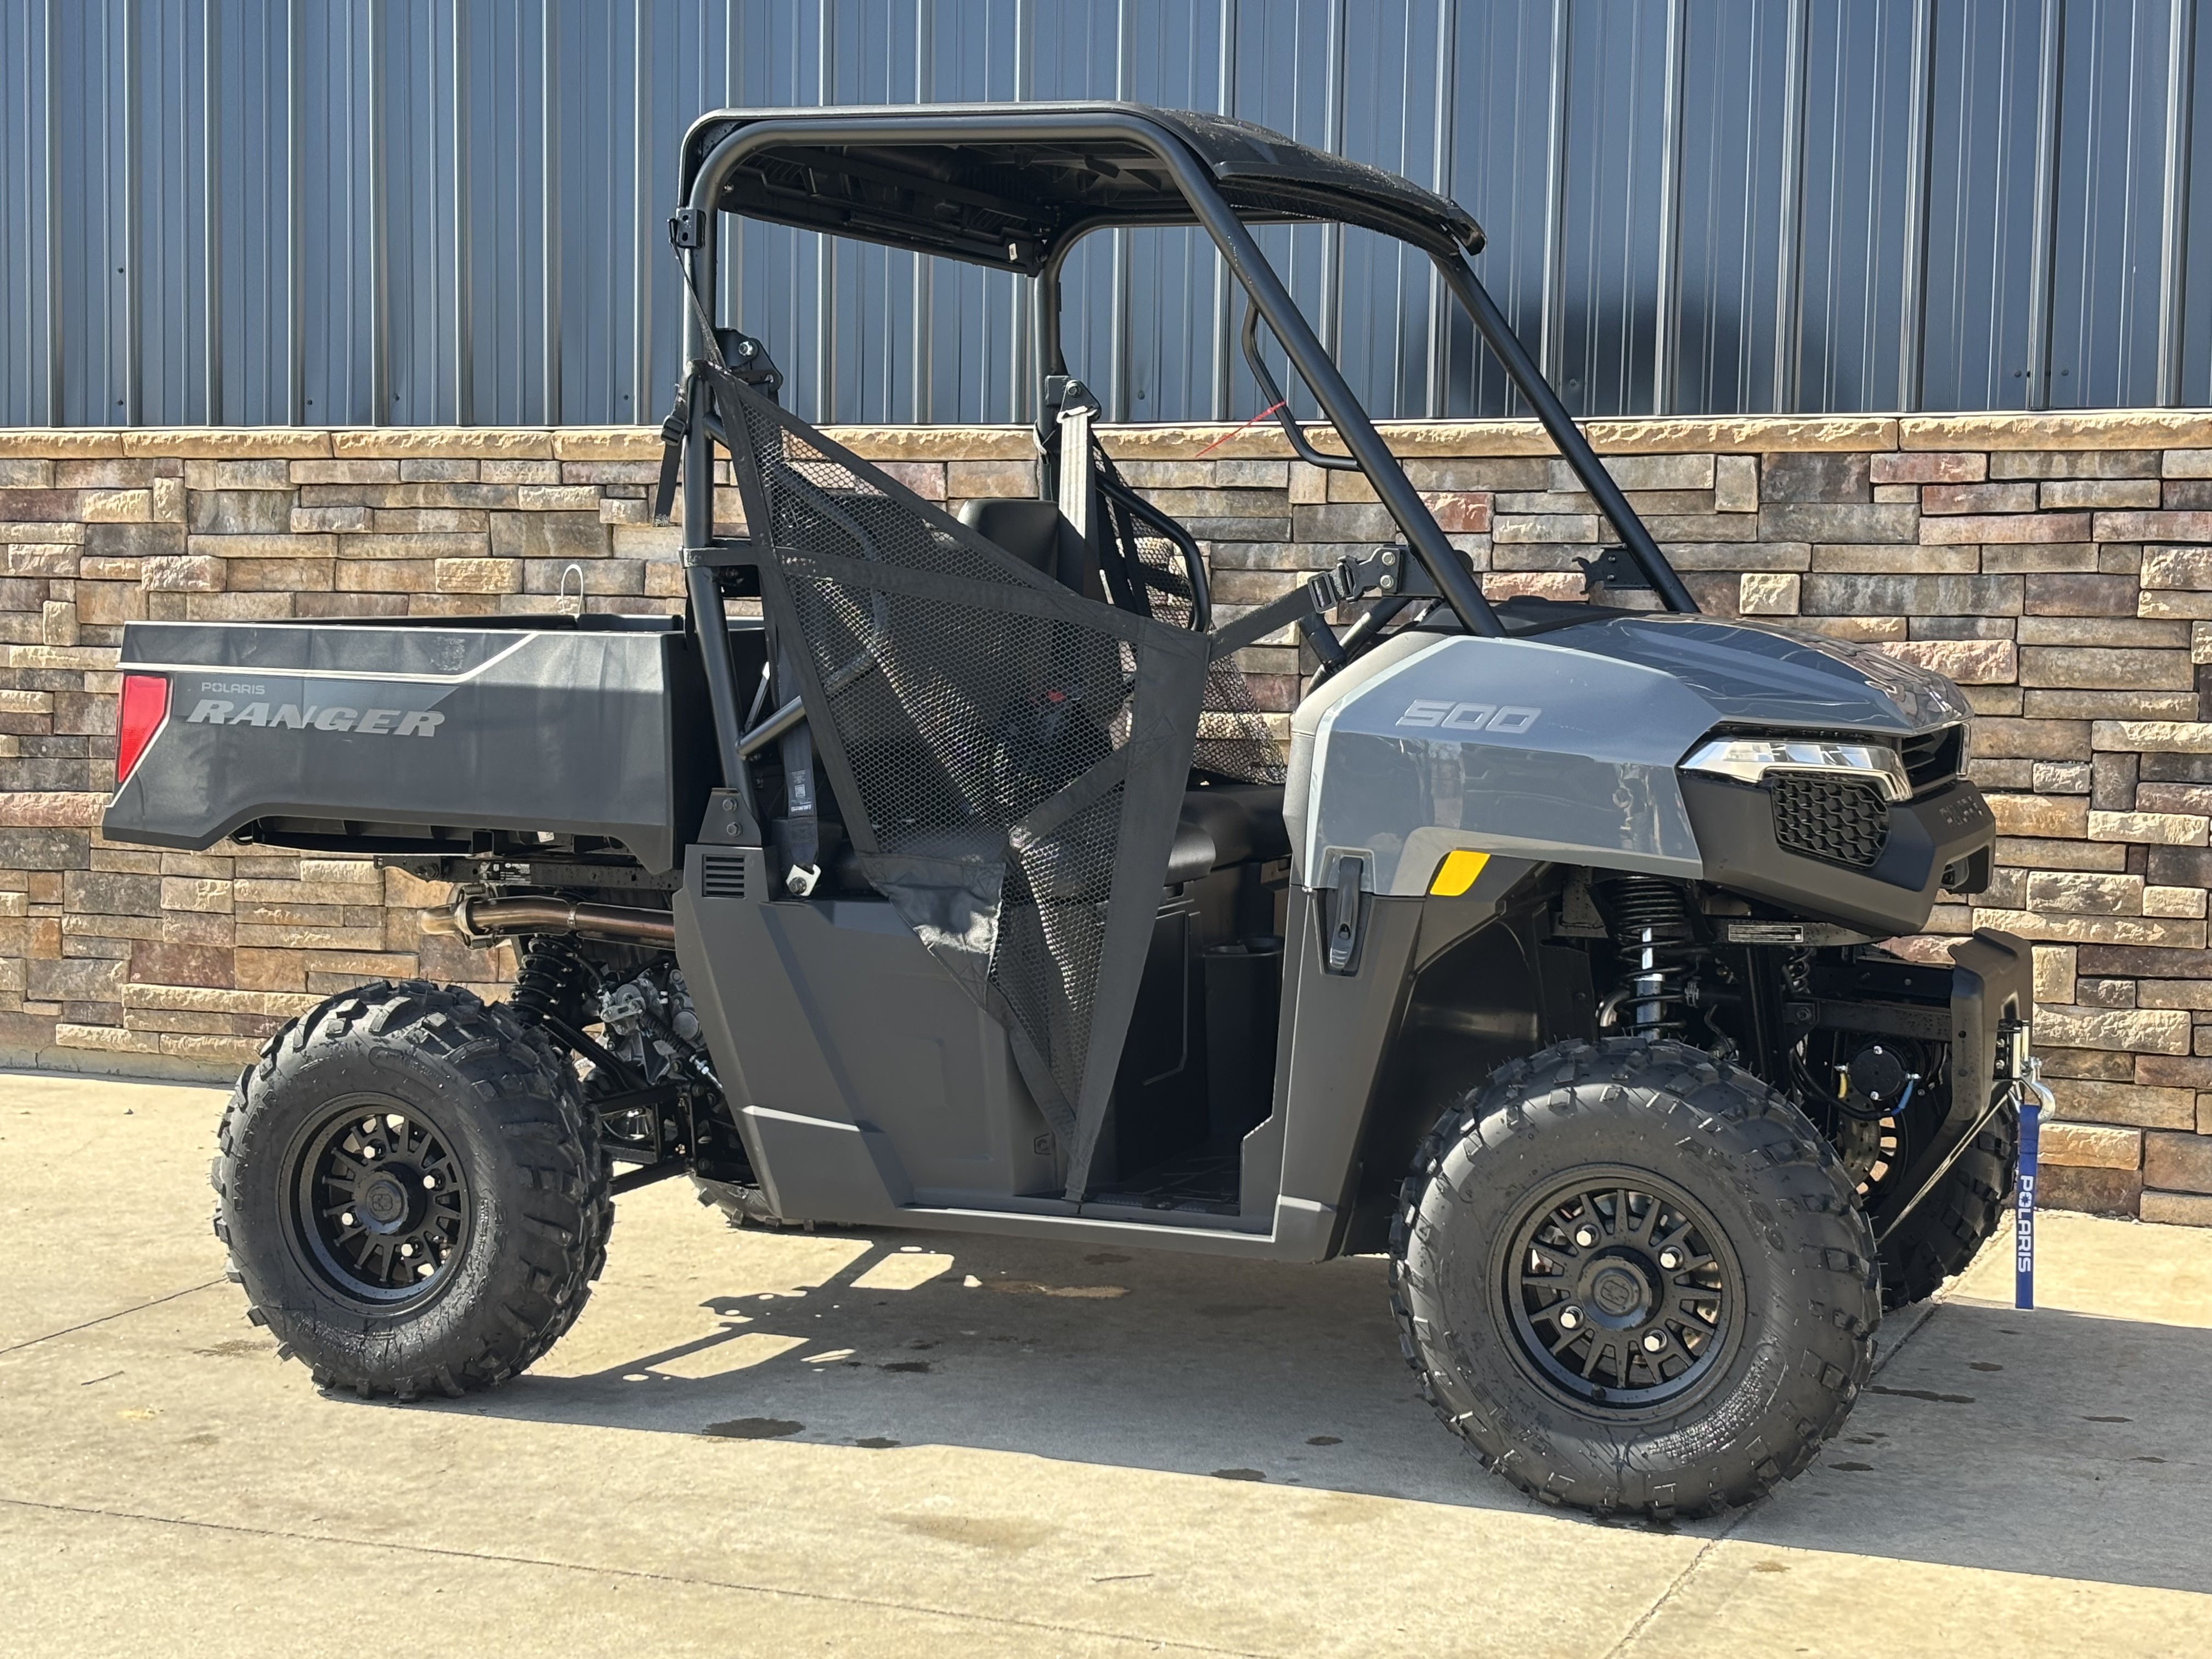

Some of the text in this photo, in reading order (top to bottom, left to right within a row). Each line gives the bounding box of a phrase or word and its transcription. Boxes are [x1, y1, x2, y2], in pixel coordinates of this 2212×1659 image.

[201, 682, 265, 695] POLARIS
[186, 699, 445, 737] RANGER
[1395, 699, 1542, 733] 500
[2018, 1175, 2034, 1273] POLARIS
